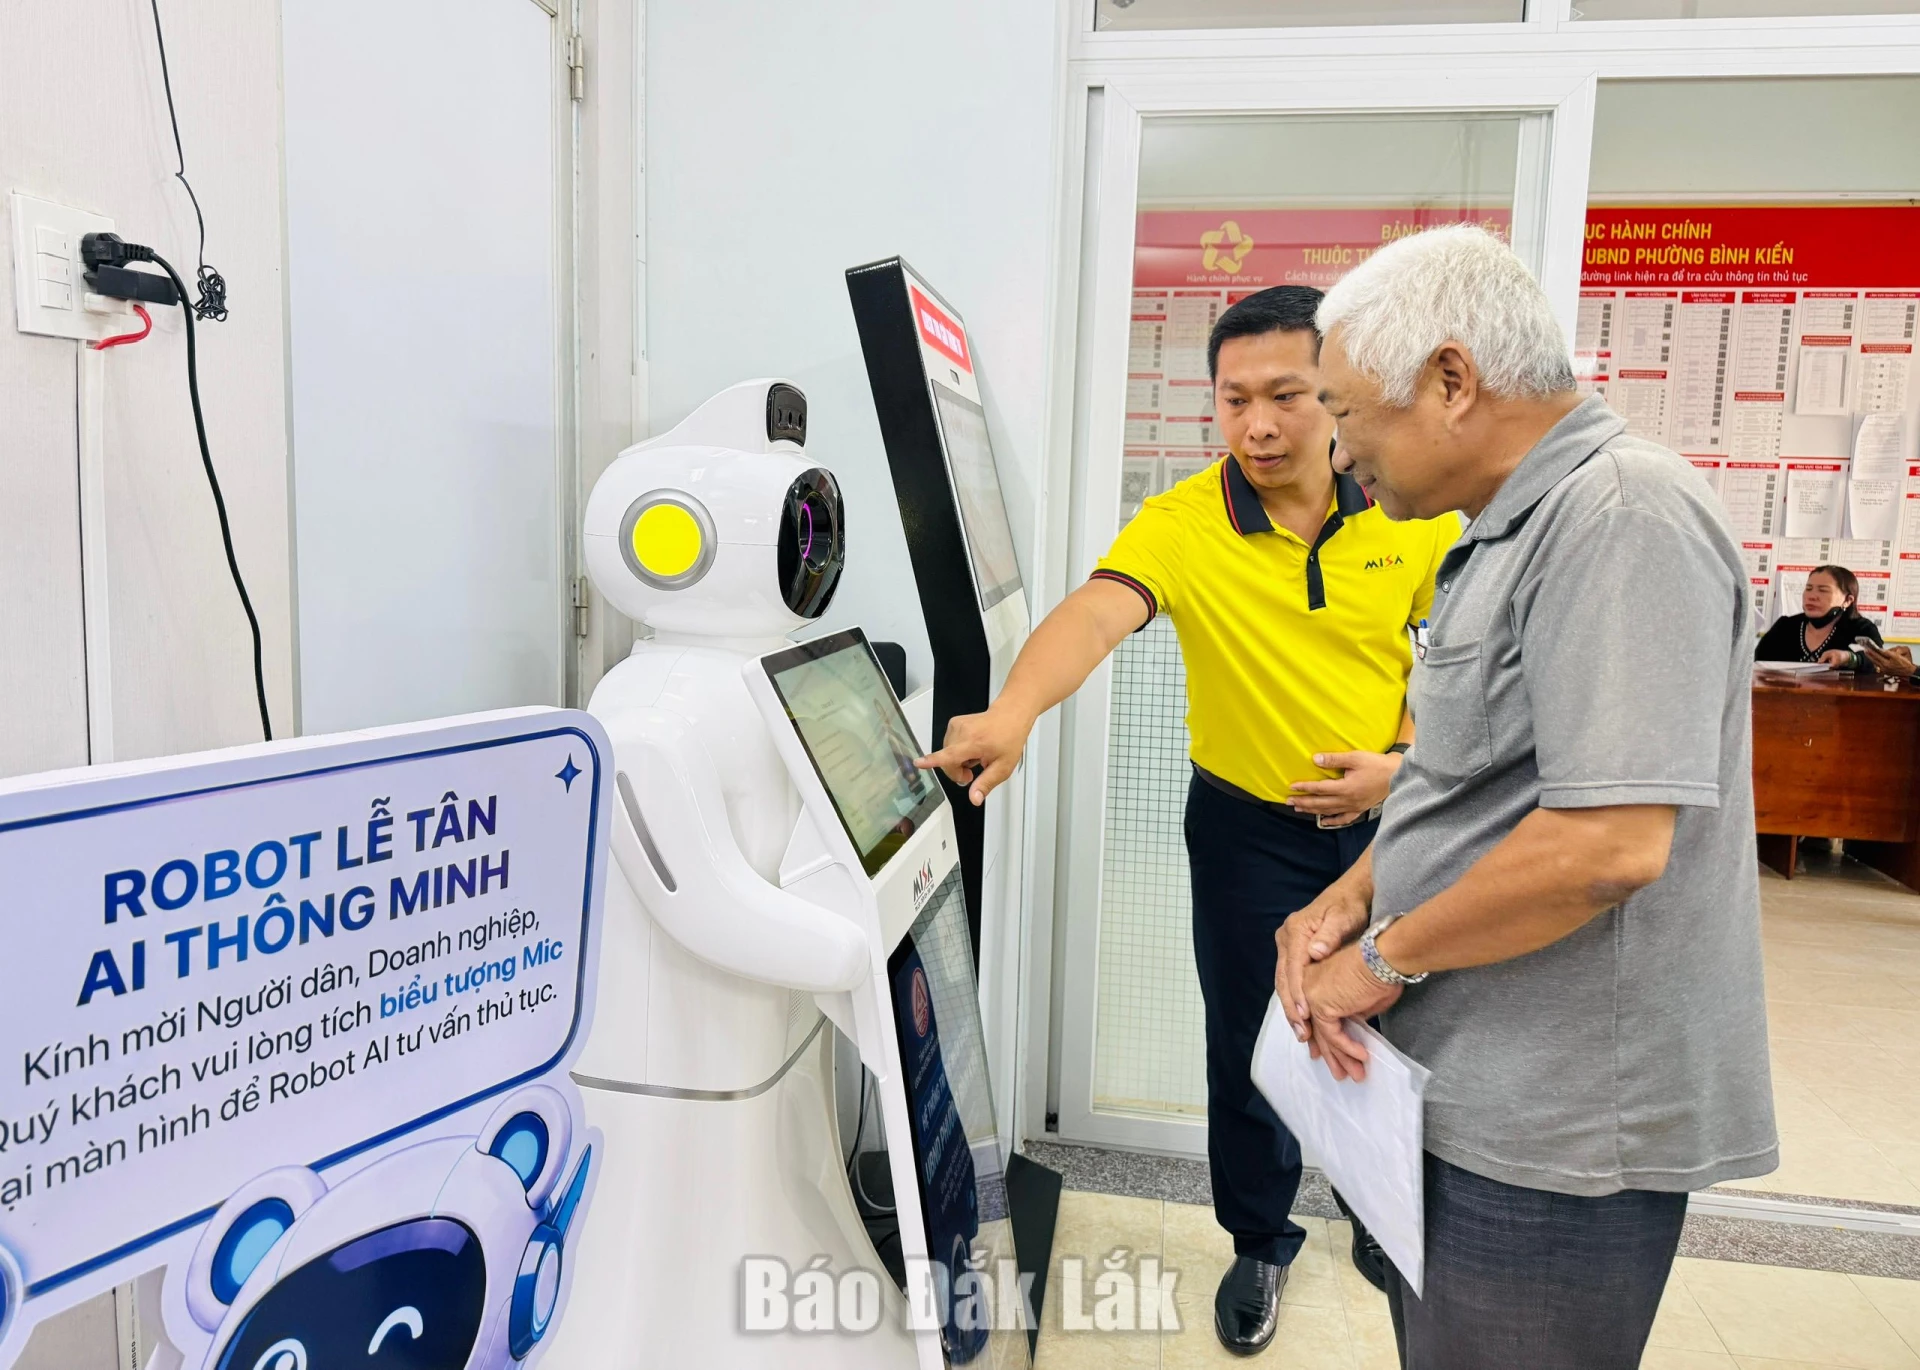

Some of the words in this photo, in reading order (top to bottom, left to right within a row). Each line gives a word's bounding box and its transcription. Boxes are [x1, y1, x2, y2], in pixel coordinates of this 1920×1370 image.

[1302, 244, 1352, 269] THUỘC
[1584, 223, 1606, 244] ỤC
[1610, 219, 1656, 240] HÀNH
[1661, 218, 1713, 240] CHÍNH
[1585, 247, 1630, 265] UBND
[1635, 243, 1705, 265] PHƯỜNG
[1709, 243, 1750, 265] BÌNH
[1754, 240, 1794, 265] KIẾN
[1614, 270, 1632, 282] link
[1634, 270, 1656, 284] hiện
[1658, 272, 1669, 282] ra
[1671, 268, 1686, 282] để
[1687, 271, 1702, 282] tra
[1704, 270, 1723, 282] cứu
[1725, 270, 1754, 285] thông
[1757, 271, 1770, 282] tin
[1773, 269, 1789, 282] thủ
[1792, 272, 1809, 284] tục
[1364, 554, 1404, 570] MISA
[104, 830, 322, 925] ROBOT
[337, 796, 394, 871] LỄ
[407, 790, 497, 853] TÂN
[76, 939, 145, 1008] AI
[164, 885, 375, 979] THÔNG
[389, 849, 510, 921] MINH
[24, 1033, 110, 1086] Kính
[122, 1007, 186, 1056] mời
[197, 975, 292, 1032] Người
[300, 963, 360, 999] dân,
[368, 931, 451, 978] Doanh
[458, 908, 540, 951] nghiệp,
[71, 1063, 181, 1126] khách
[191, 1040, 238, 1083] vui
[248, 1023, 312, 1064] lòng
[320, 1000, 372, 1039] tích
[380, 974, 438, 1019] biểu
[444, 956, 517, 996] tượng
[522, 938, 564, 971] Mic
[0, 1164, 32, 1212] ại
[46, 1139, 126, 1189] màn
[138, 1103, 210, 1153] hình
[220, 1075, 260, 1121] để
[269, 1051, 356, 1104] Robot
[362, 1035, 389, 1069] AI
[396, 1024, 424, 1056] tư
[428, 1005, 471, 1044] vấn
[476, 991, 513, 1026] thủ
[518, 983, 558, 1013] tục.
